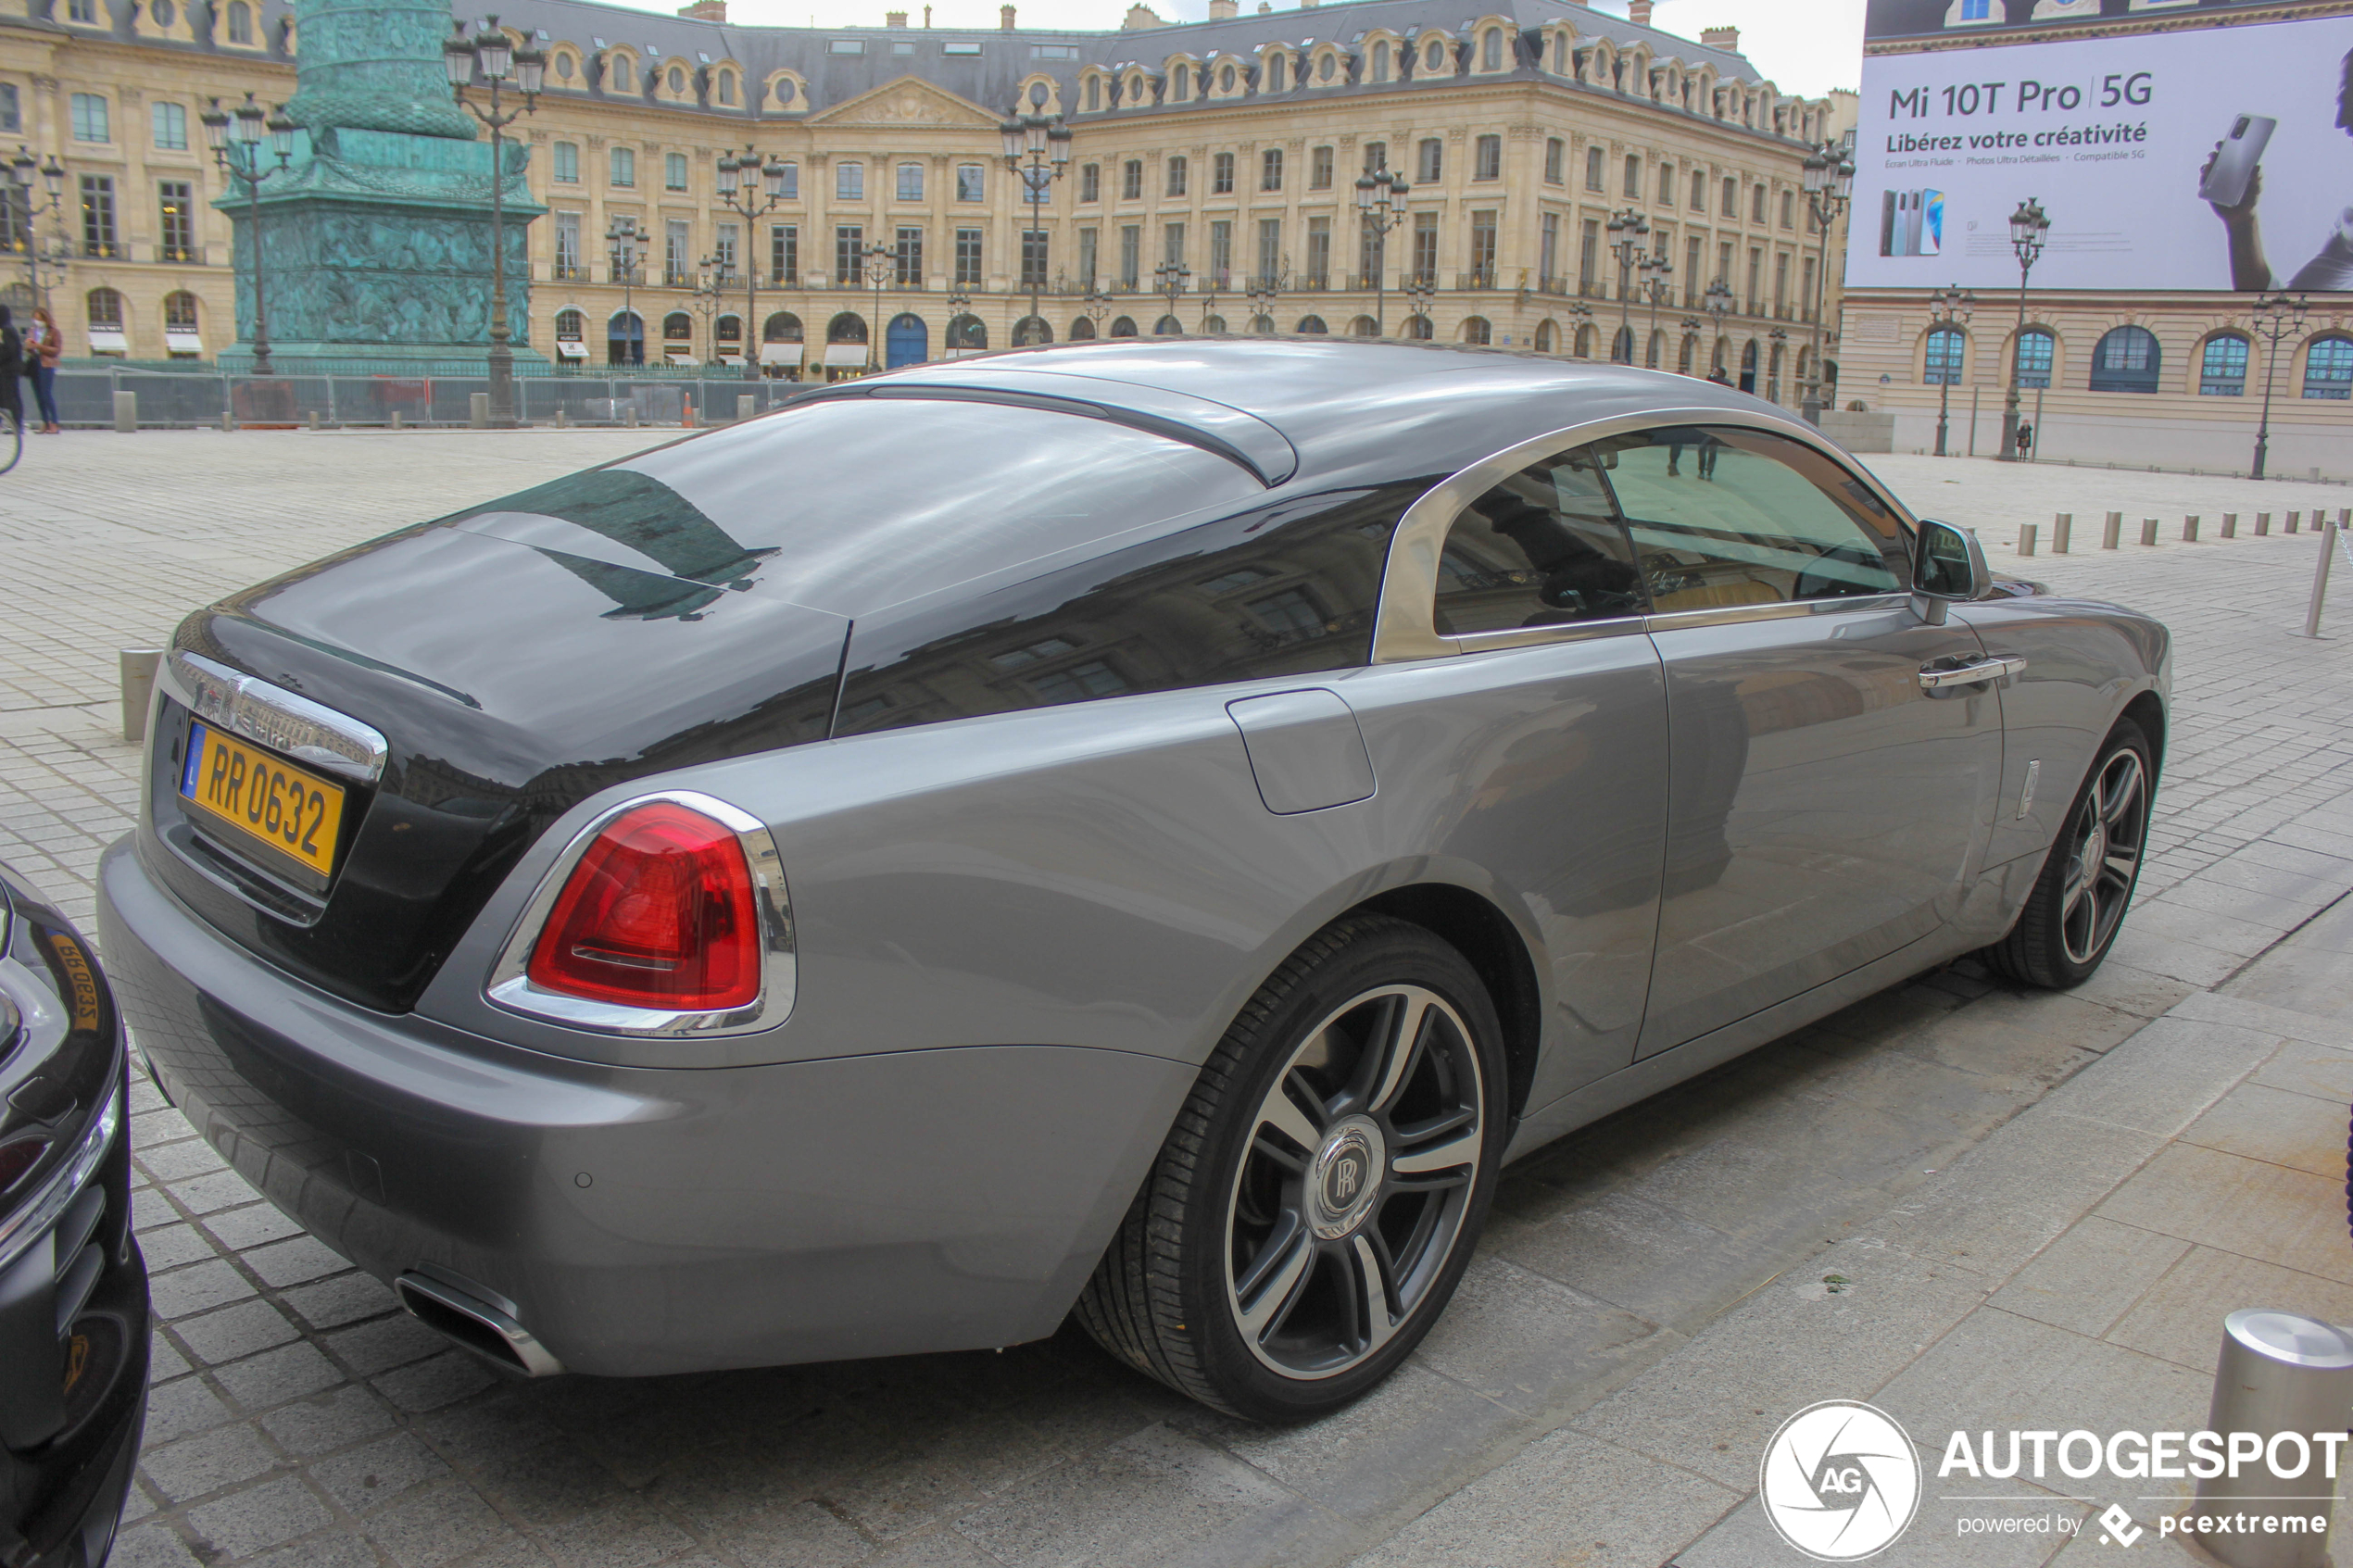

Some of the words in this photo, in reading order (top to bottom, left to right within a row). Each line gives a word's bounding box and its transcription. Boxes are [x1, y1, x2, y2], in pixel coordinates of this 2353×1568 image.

[1889, 86, 1929, 119] Mi
[1942, 82, 2006, 116] 10T
[2017, 80, 2081, 112] Pro
[2100, 71, 2152, 107] 5G
[1886, 133, 1962, 153] Libérez
[1969, 131, 2027, 148] votre
[2033, 121, 2146, 146] créativité
[1908, 157, 1928, 168] Ultra
[1930, 156, 1954, 166] Fluide
[1966, 155, 1994, 165] Photos
[1996, 154, 2018, 164] Ultra
[2019, 153, 2060, 163] Détaillées
[2073, 150, 2129, 162] Compatible
[2132, 149, 2145, 159] 5G
